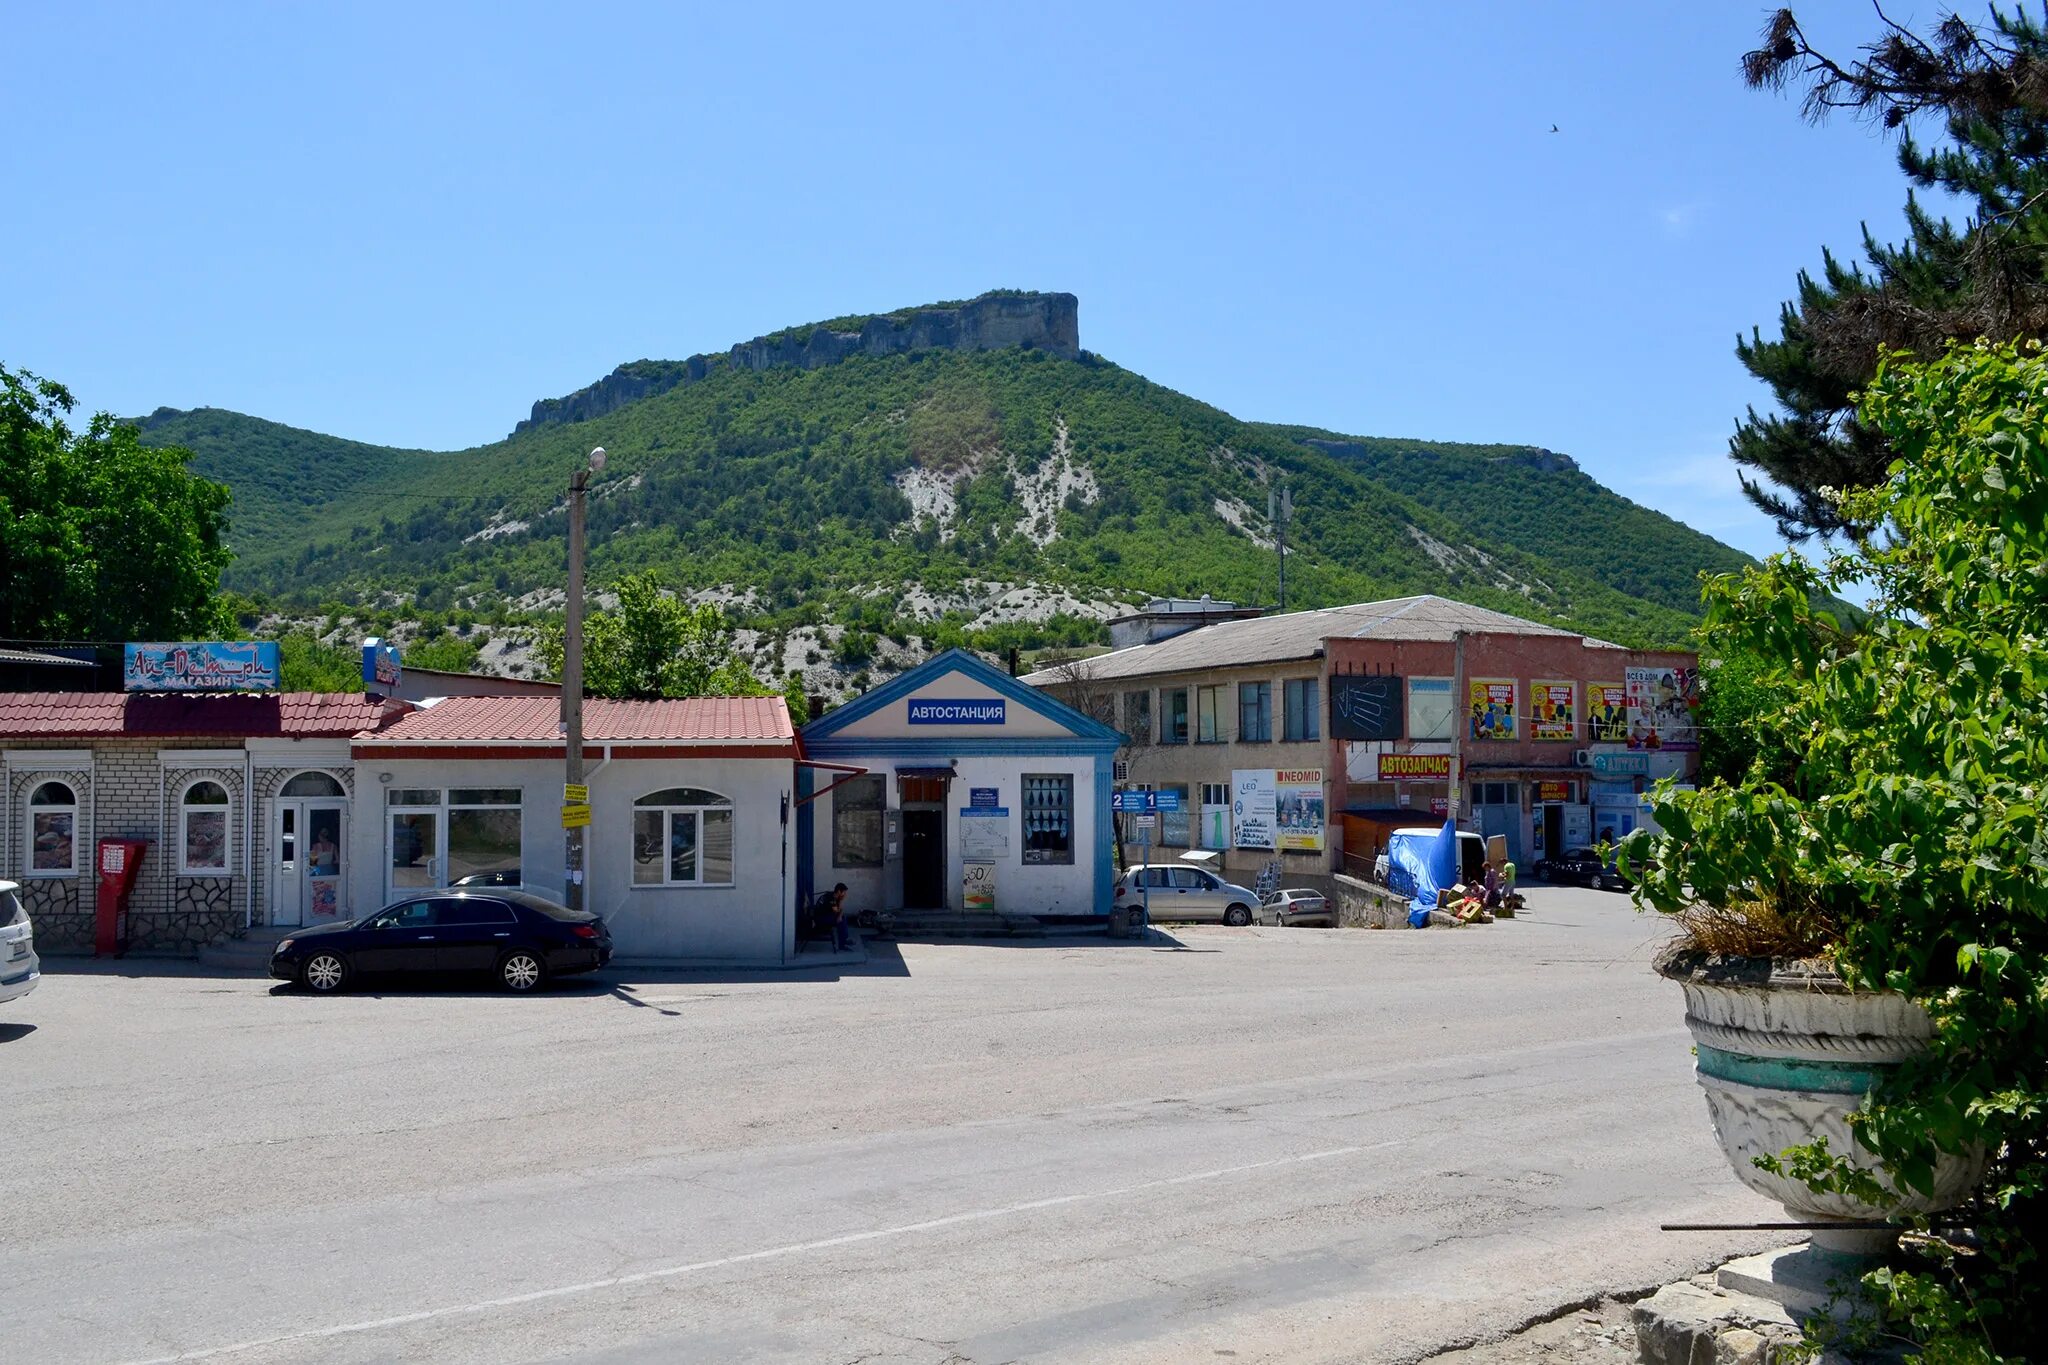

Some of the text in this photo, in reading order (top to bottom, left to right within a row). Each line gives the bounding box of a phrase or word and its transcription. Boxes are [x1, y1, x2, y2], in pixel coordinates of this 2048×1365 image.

[165, 676, 232, 686] МАГАЗИН
[911, 706, 1003, 720] АВТОСТАНЦИЯ
[1284, 771, 1321, 782] NEOMID
[1541, 783, 1557, 791] АВТО
[1113, 794, 1122, 806] 2
[1147, 794, 1154, 806] 1
